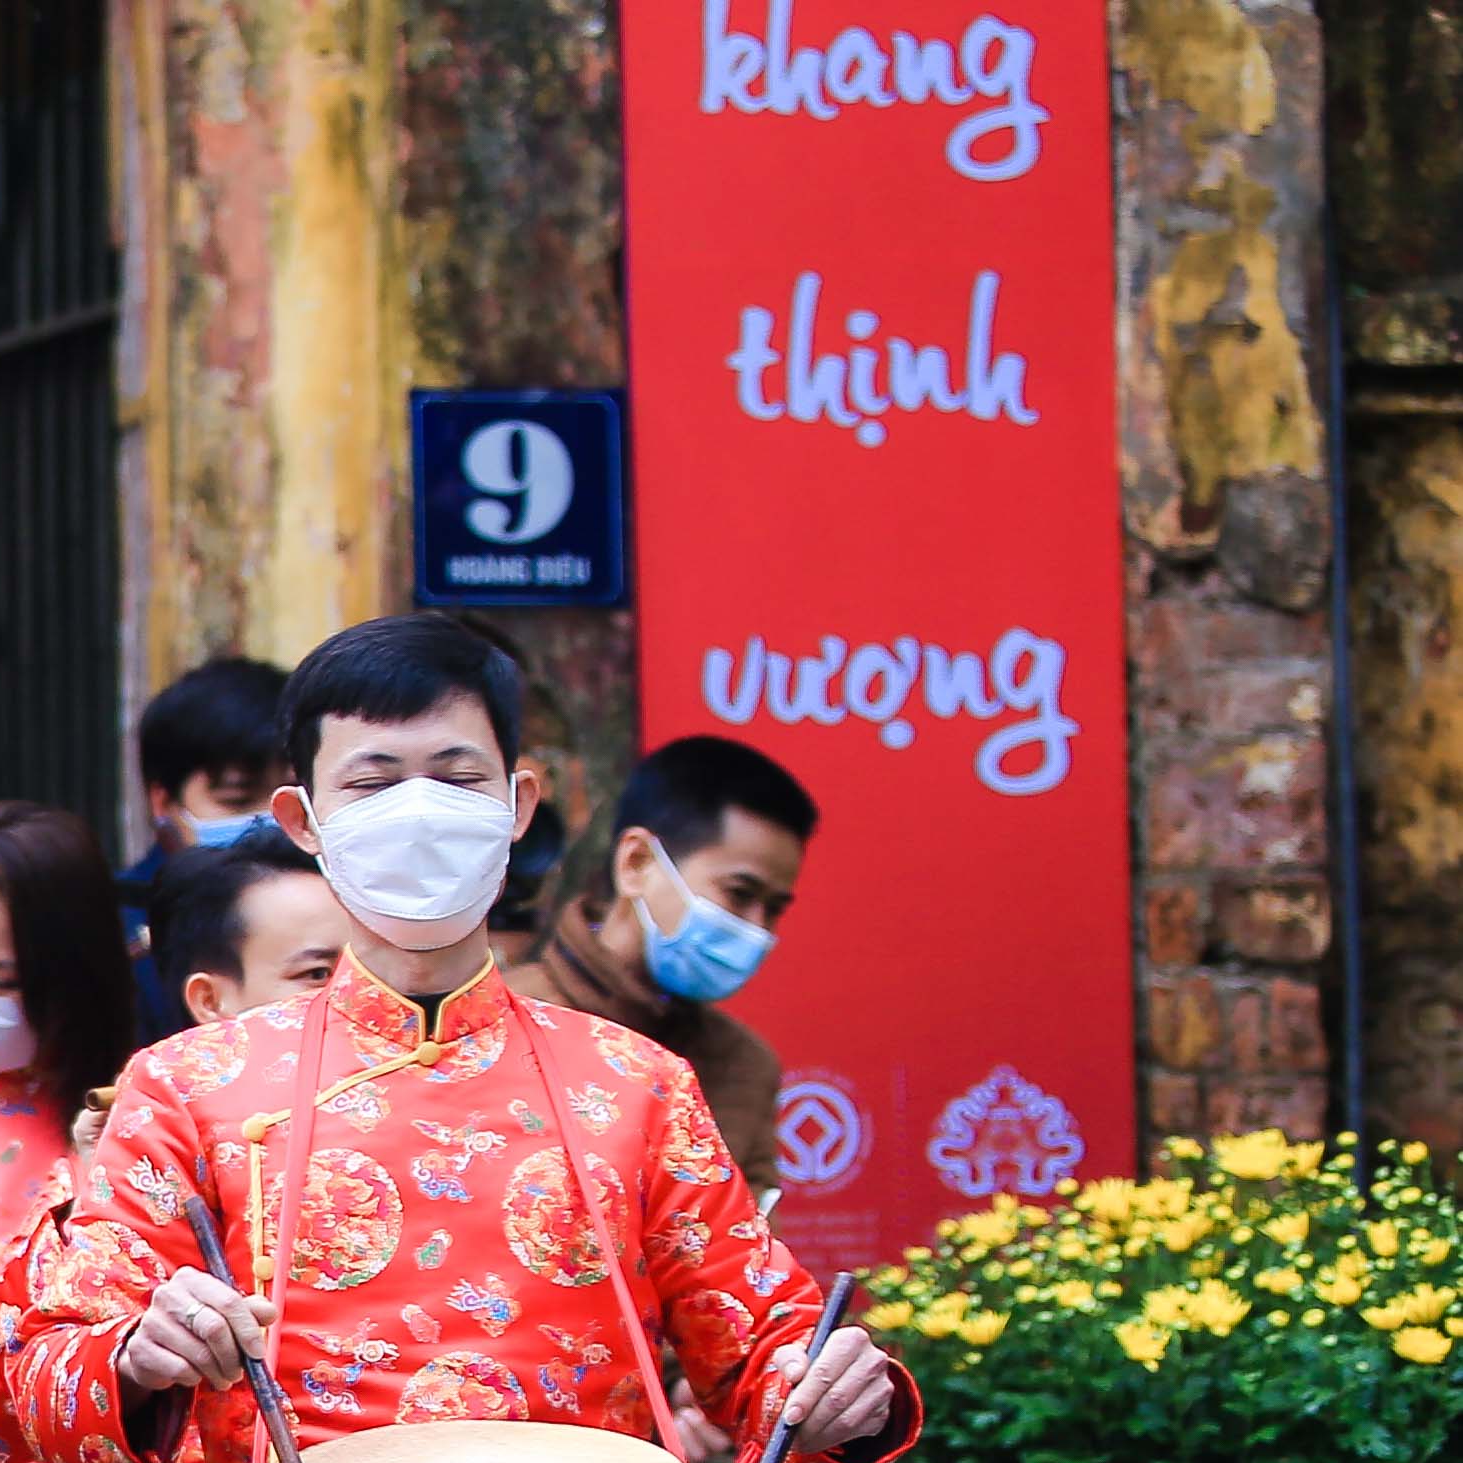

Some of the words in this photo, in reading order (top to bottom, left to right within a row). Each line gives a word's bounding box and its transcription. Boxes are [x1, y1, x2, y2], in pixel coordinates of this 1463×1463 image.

[699, 0, 1050, 182] khang
[726, 271, 1039, 448] thịnh
[463, 420, 574, 544] 9
[701, 628, 1078, 796] vượng
